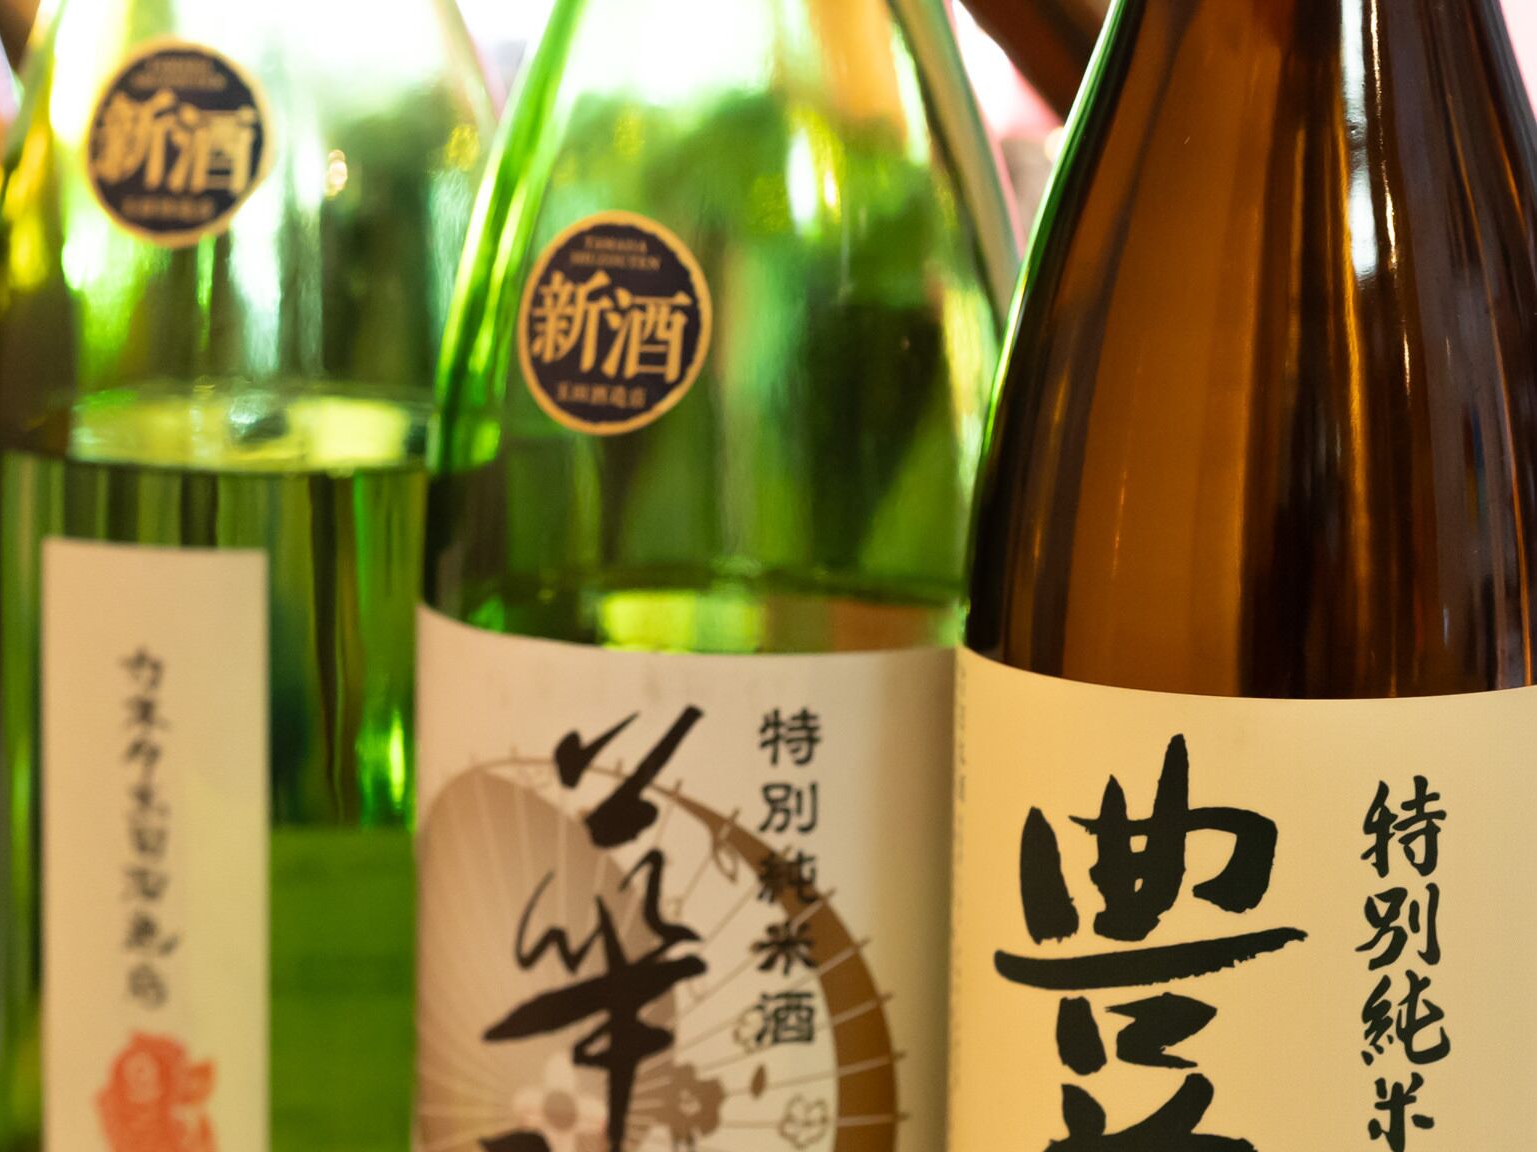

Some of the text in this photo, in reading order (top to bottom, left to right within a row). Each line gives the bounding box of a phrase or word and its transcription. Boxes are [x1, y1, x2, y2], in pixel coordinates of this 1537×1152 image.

[97, 88, 255, 192] 新酒
[531, 268, 693, 382] 新酒
[755, 706, 825, 1046] 特別純米酒
